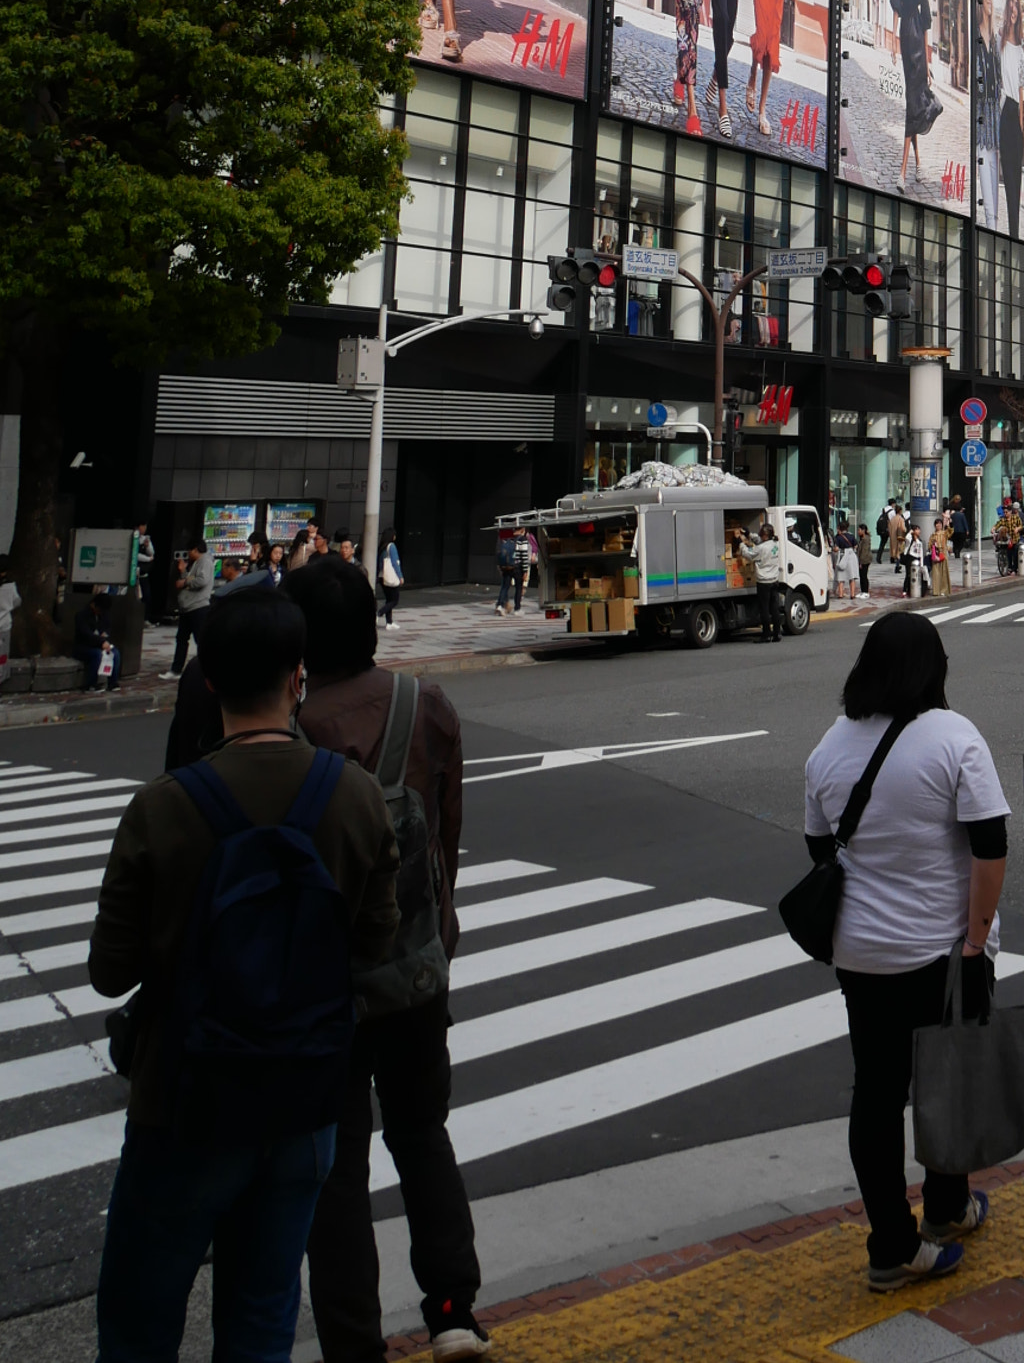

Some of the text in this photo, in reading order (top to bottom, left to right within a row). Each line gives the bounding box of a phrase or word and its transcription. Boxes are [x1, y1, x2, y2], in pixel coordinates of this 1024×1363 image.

[510, 9, 575, 79] H&M
[780, 98, 820, 153] H&M
[941, 159, 966, 203] H&M
[626, 251, 677, 267] 道玄坂二丁目
[771, 251, 824, 267] 道玄坂二丁目
[627, 264, 675, 275] Dogenzaka 2-chome
[772, 265, 822, 276] Dogenzaka 2-chome
[967, 445, 977, 463] P
